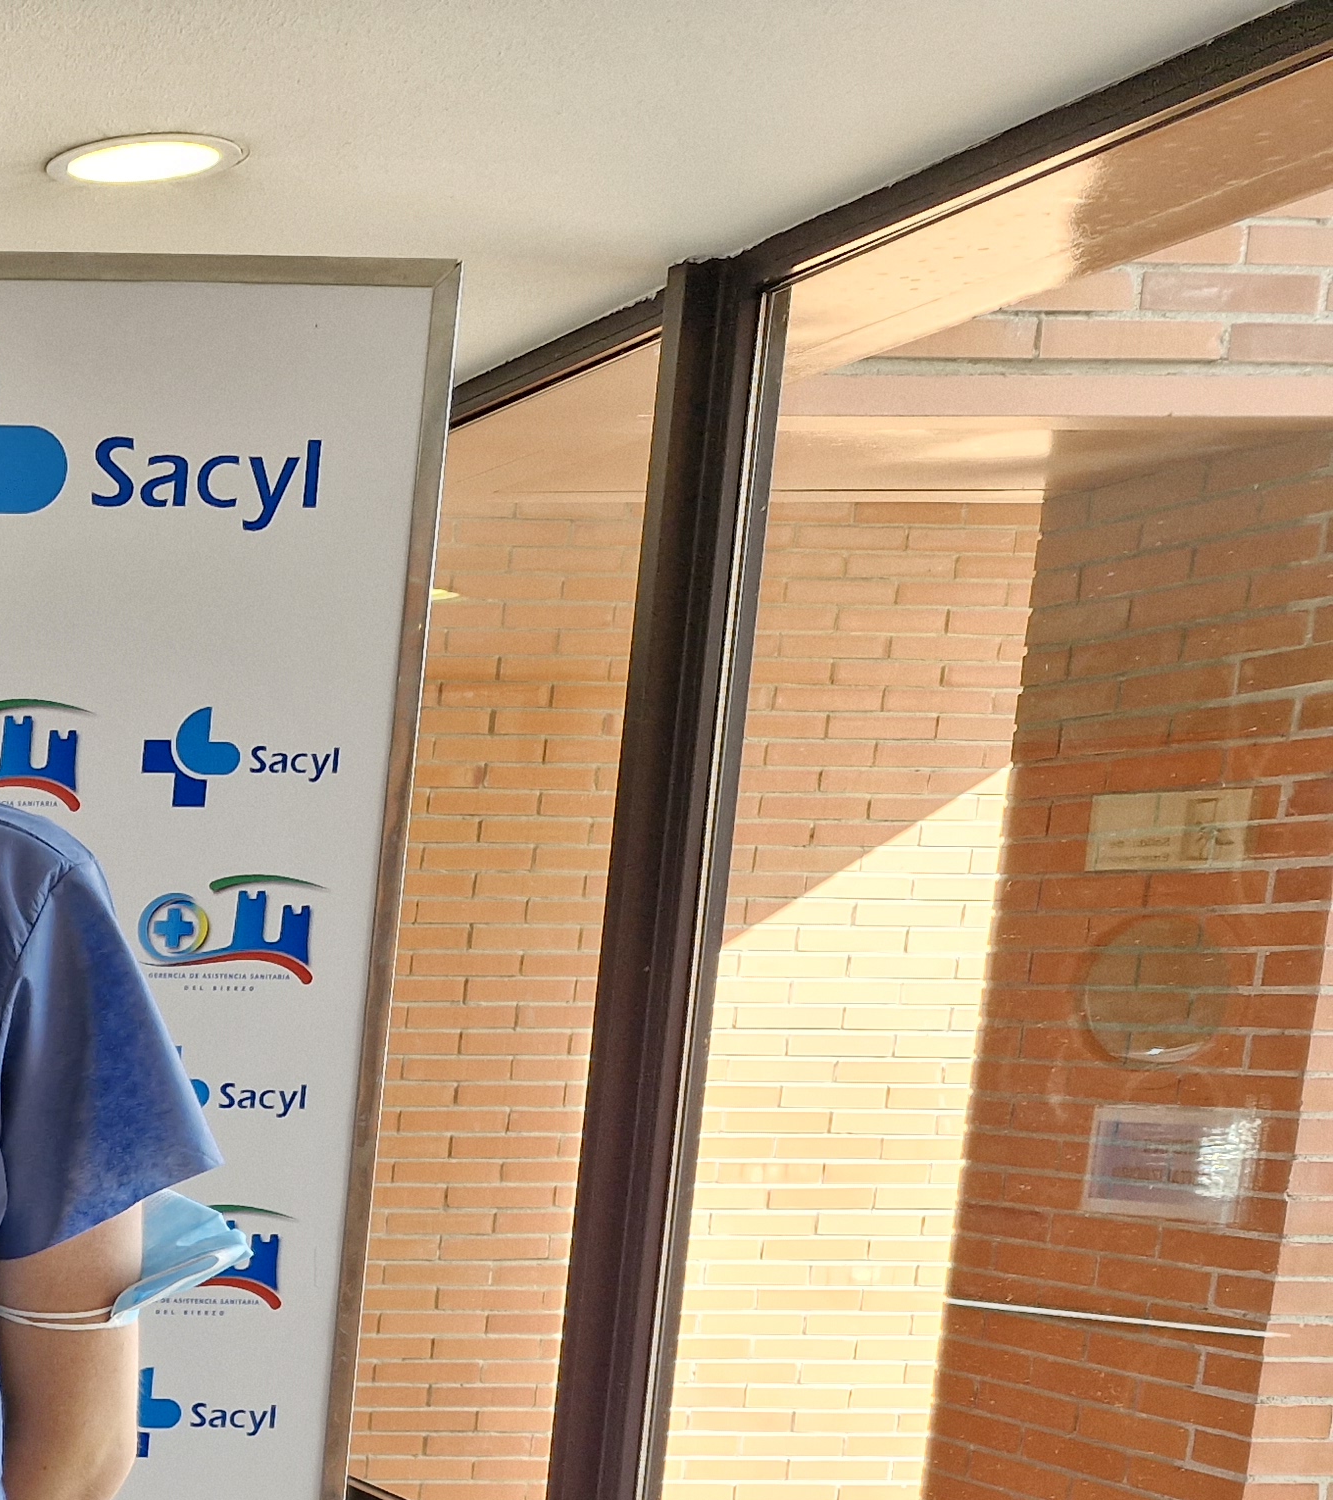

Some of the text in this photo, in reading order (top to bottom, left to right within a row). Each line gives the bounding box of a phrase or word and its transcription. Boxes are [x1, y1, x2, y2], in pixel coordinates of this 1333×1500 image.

[90, 435, 323, 532] Sacyl
[248, 744, 340, 783] Sacyl
[217, 1081, 307, 1118] Sacyl
[189, 1401, 277, 1437] Sacyl
